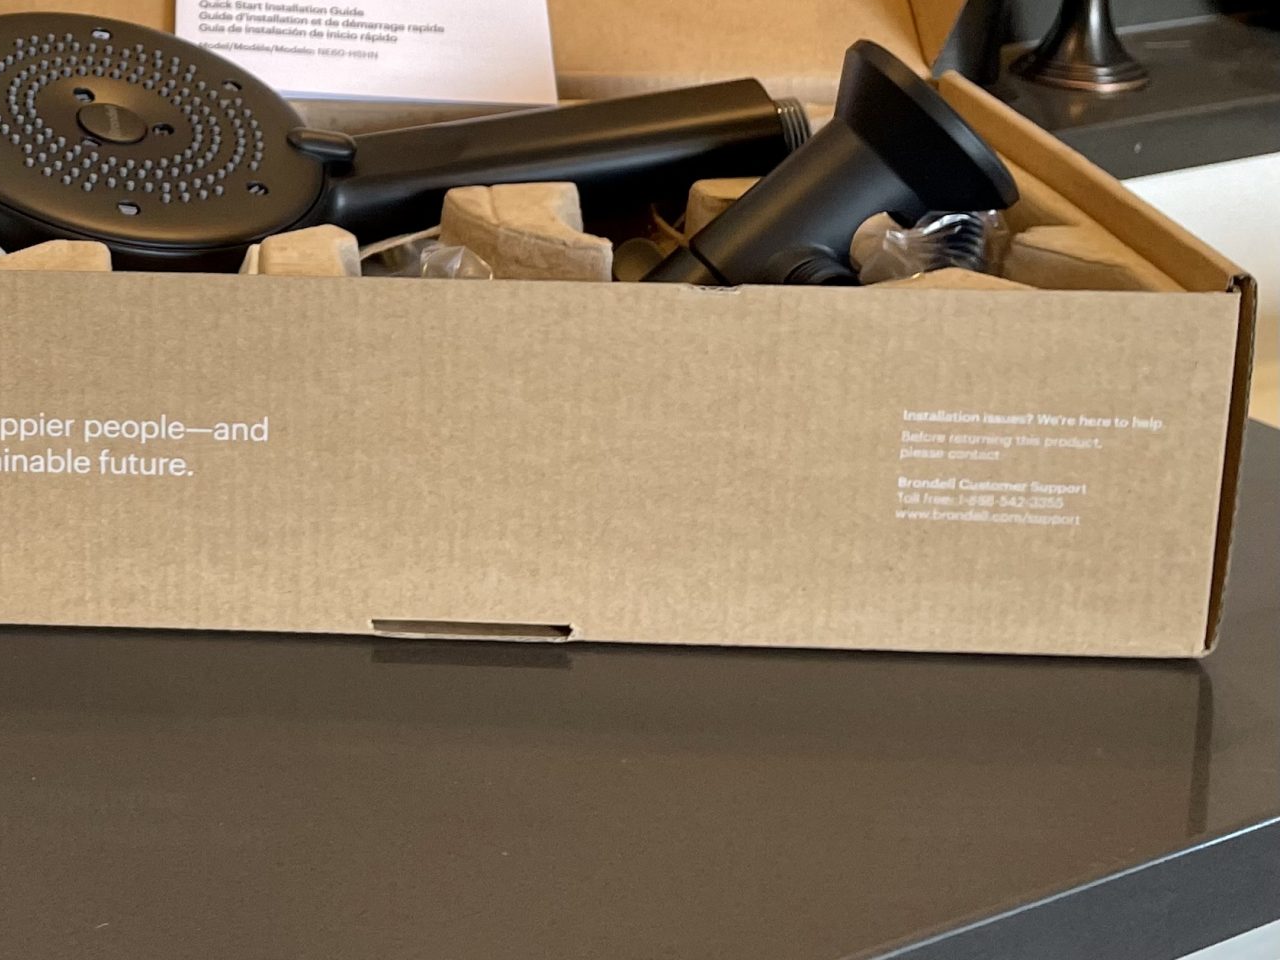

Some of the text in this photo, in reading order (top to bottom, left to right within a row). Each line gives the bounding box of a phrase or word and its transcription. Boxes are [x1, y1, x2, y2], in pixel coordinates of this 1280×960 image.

[198, 0, 364, 17] Quick Start Installation Guide
[198, 12, 233, 22] Guide
[235, 13, 308, 26] d'installation
[311, 17, 322, 26] et
[325, 17, 339, 27] de
[342, 18, 405, 33] démarrage
[228, 24, 242, 34] de
[245, 24, 306, 37] instalación
[309, 28, 324, 38] de
[327, 29, 358, 41] inicio
[360, 30, 398, 43] rápido
[903, 410, 980, 424] Installation
[983, 413, 1034, 426] issues?
[1037, 414, 1072, 427] We're
[1079, 415, 1111, 428] here
[1114, 417, 1128, 428] to
[901, 430, 946, 444] Before
[949, 432, 1012, 448] returning
[1016, 434, 1041, 446] this
[99, 449, 195, 477] future.
[900, 448, 1000, 461] please contact
[898, 476, 1087, 495] Brondell Customer Support
[895, 508, 1081, 526] www.brondell.com/support
